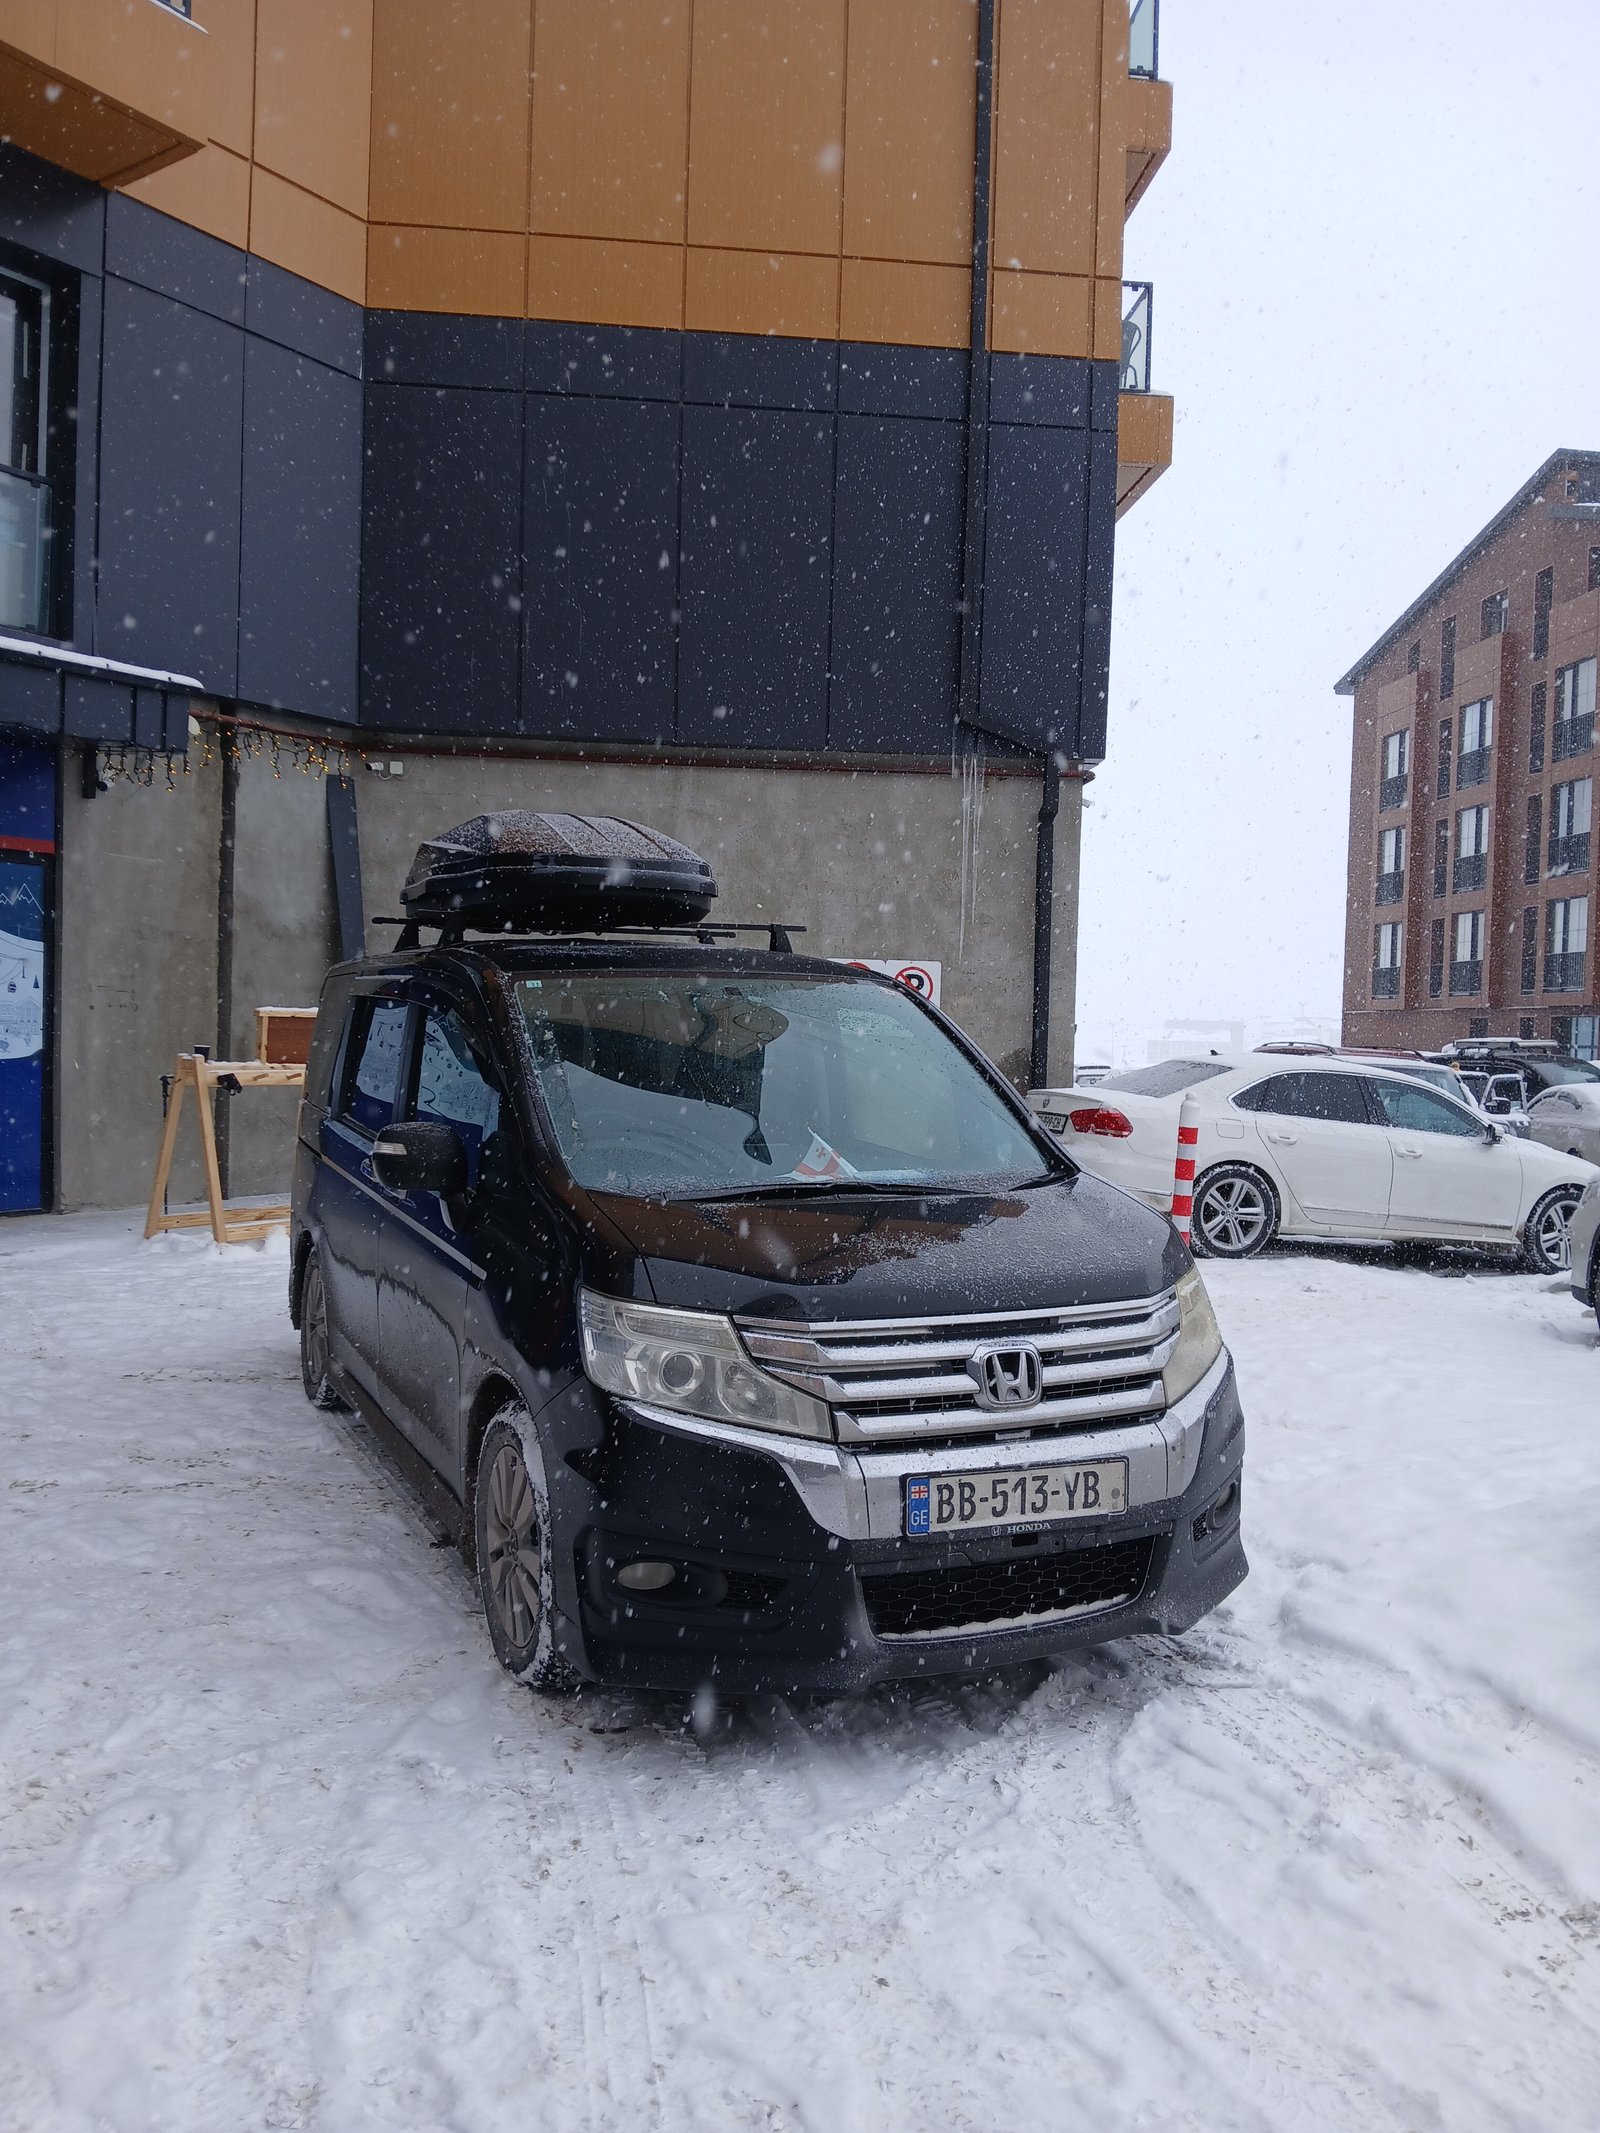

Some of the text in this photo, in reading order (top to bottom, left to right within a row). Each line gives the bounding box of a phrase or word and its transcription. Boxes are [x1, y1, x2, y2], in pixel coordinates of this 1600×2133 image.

[936, 1470, 1100, 1525] BB-513-YB
[911, 1509, 928, 1526] GE
[1007, 1522, 1051, 1534] HONDA
